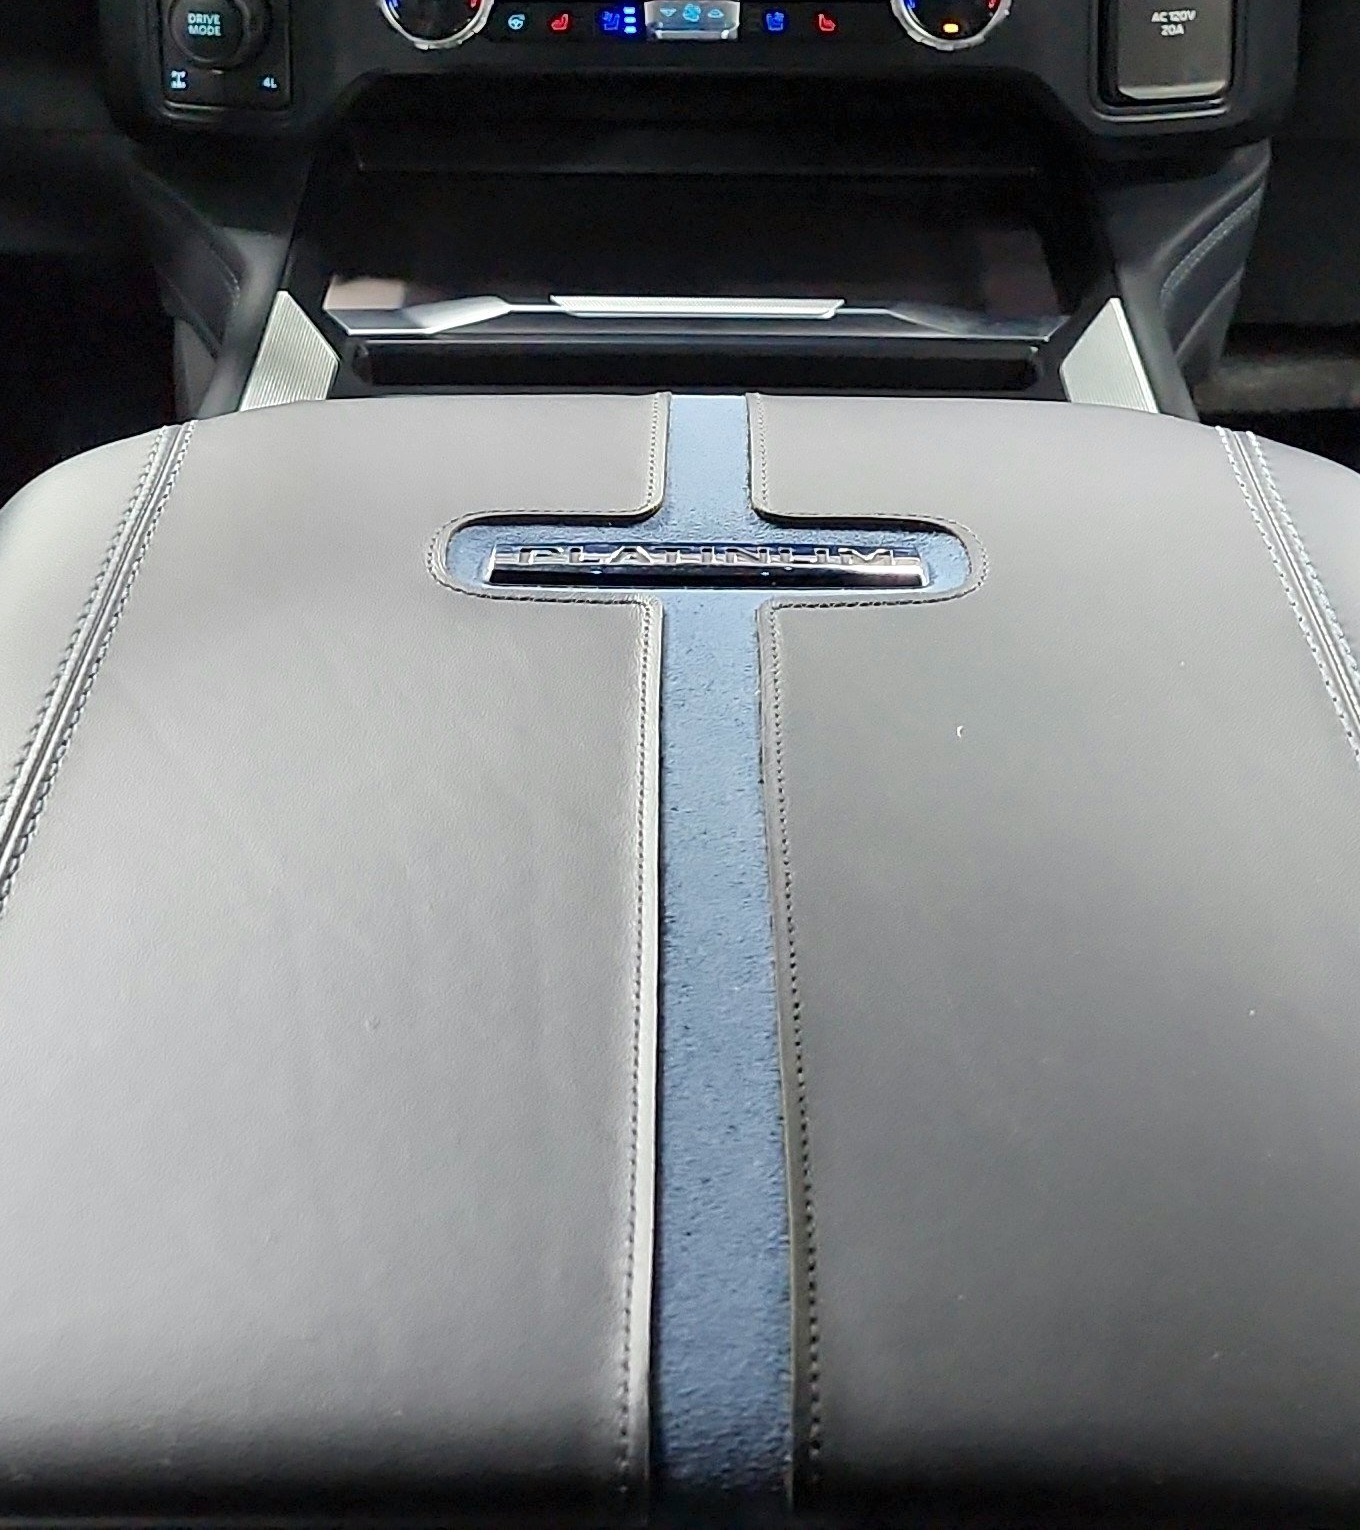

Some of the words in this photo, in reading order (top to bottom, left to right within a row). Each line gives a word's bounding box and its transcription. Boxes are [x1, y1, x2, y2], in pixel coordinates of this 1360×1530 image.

[187, 13, 221, 25] DRIVE
[187, 25, 222, 37] MODE
[1160, 23, 1185, 36] 20A
[516, 546, 899, 567] PLATINUM
